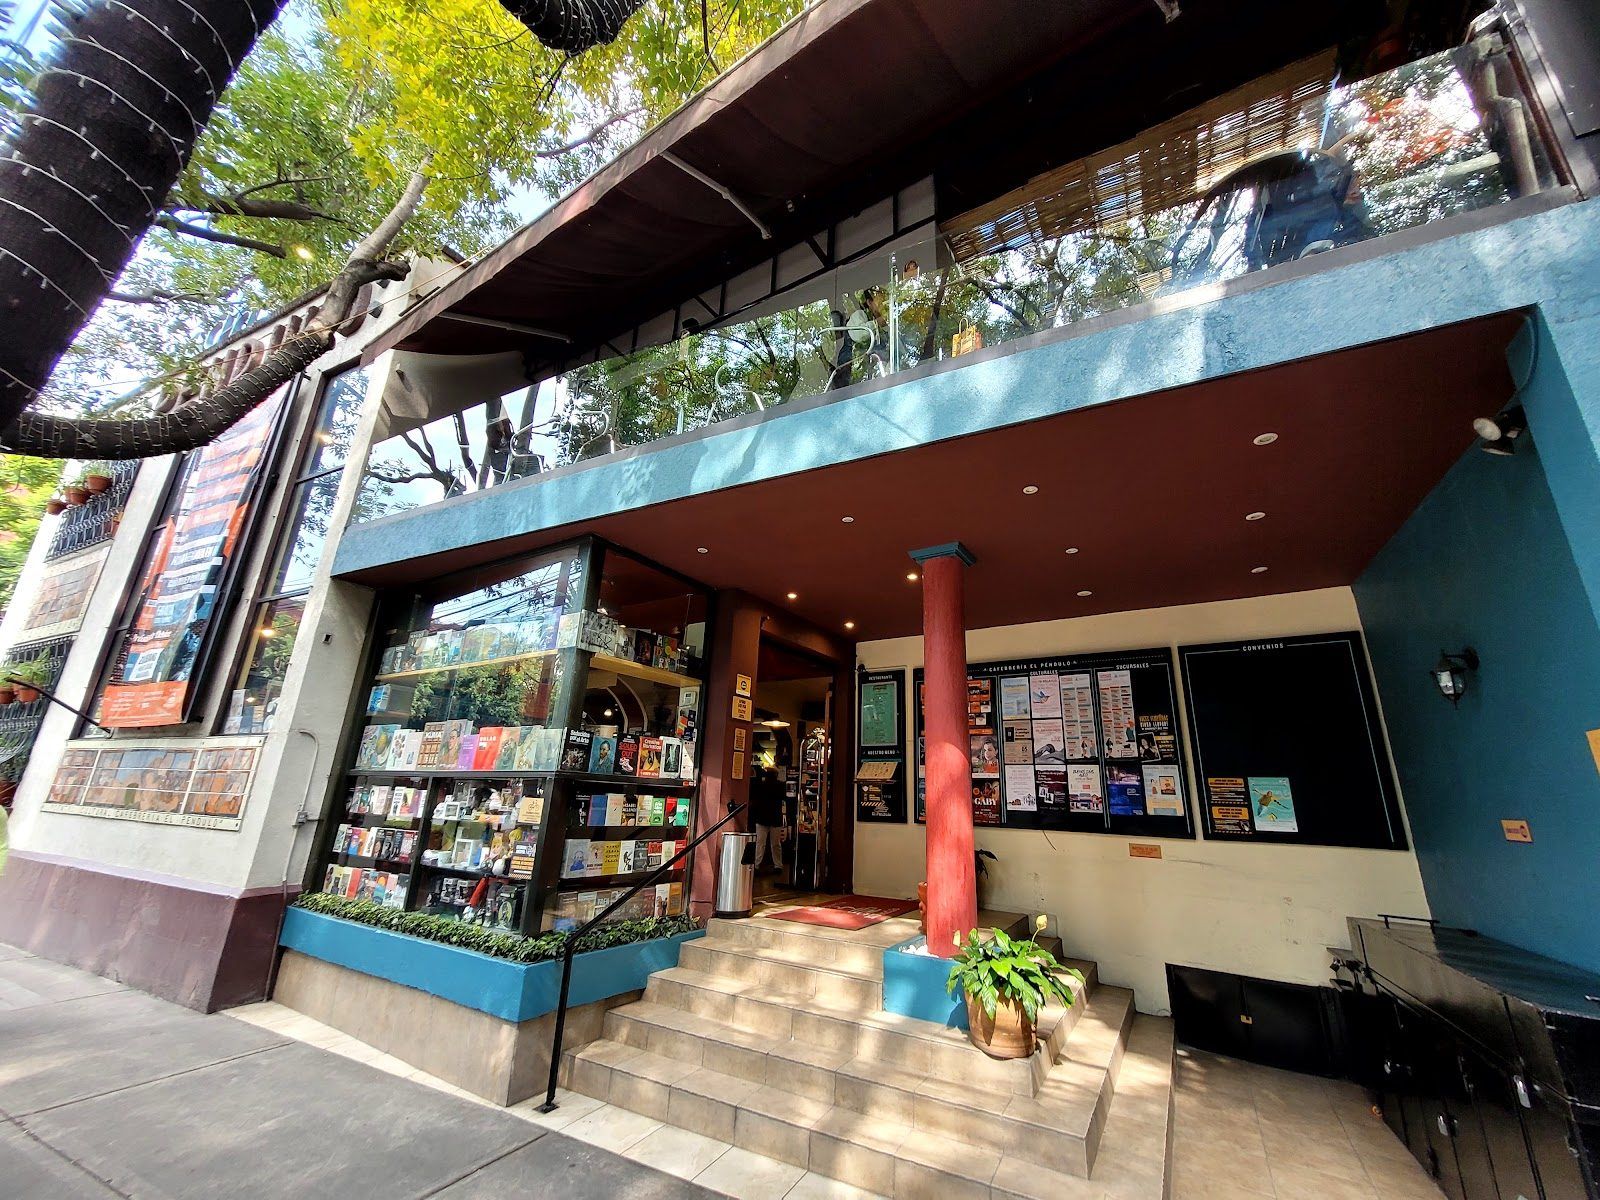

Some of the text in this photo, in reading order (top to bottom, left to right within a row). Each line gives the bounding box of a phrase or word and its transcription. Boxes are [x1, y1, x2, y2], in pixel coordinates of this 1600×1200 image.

[1242, 642, 1283, 651] CONVENIOS
[1116, 662, 1150, 670] SUCURSALES
[621, 750, 634, 758] OUT
[974, 797, 997, 806] GABY
